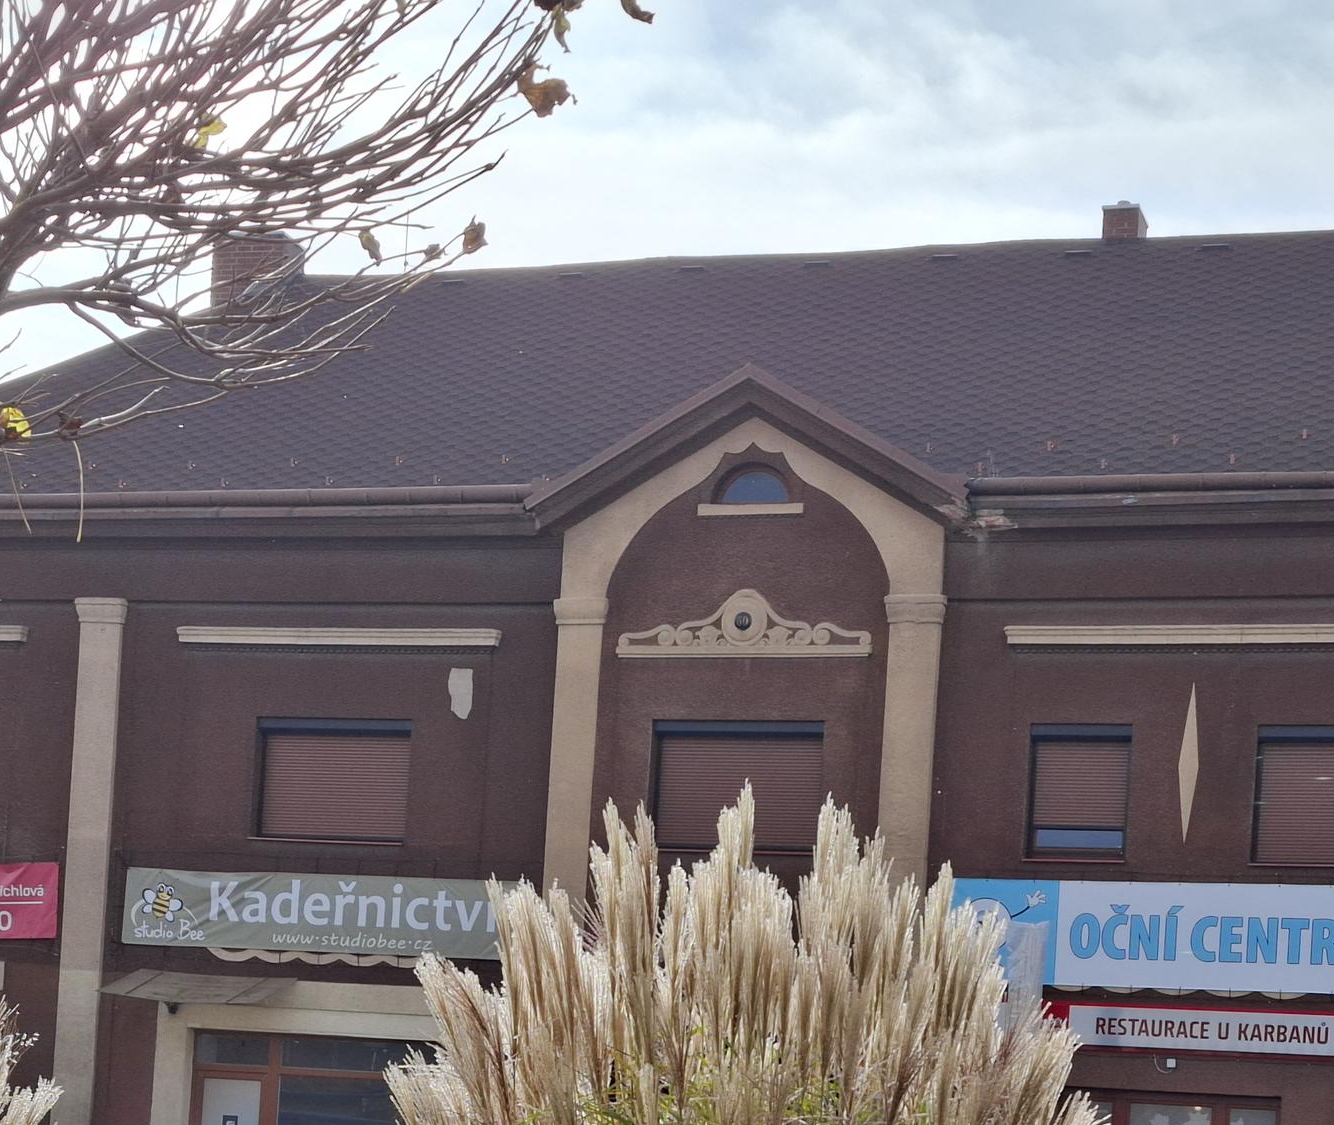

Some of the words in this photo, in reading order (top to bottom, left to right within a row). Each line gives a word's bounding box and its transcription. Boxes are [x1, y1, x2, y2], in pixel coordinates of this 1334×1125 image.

[134, 922, 174, 939] studio
[178, 919, 206, 941] Bee
[1069, 904, 1184, 961] OČNÍ
[1095, 1017, 1210, 1040] RESTAURACE
[1218, 1022, 1229, 1041] U
[1238, 1021, 1330, 1045] KARBANŮ
